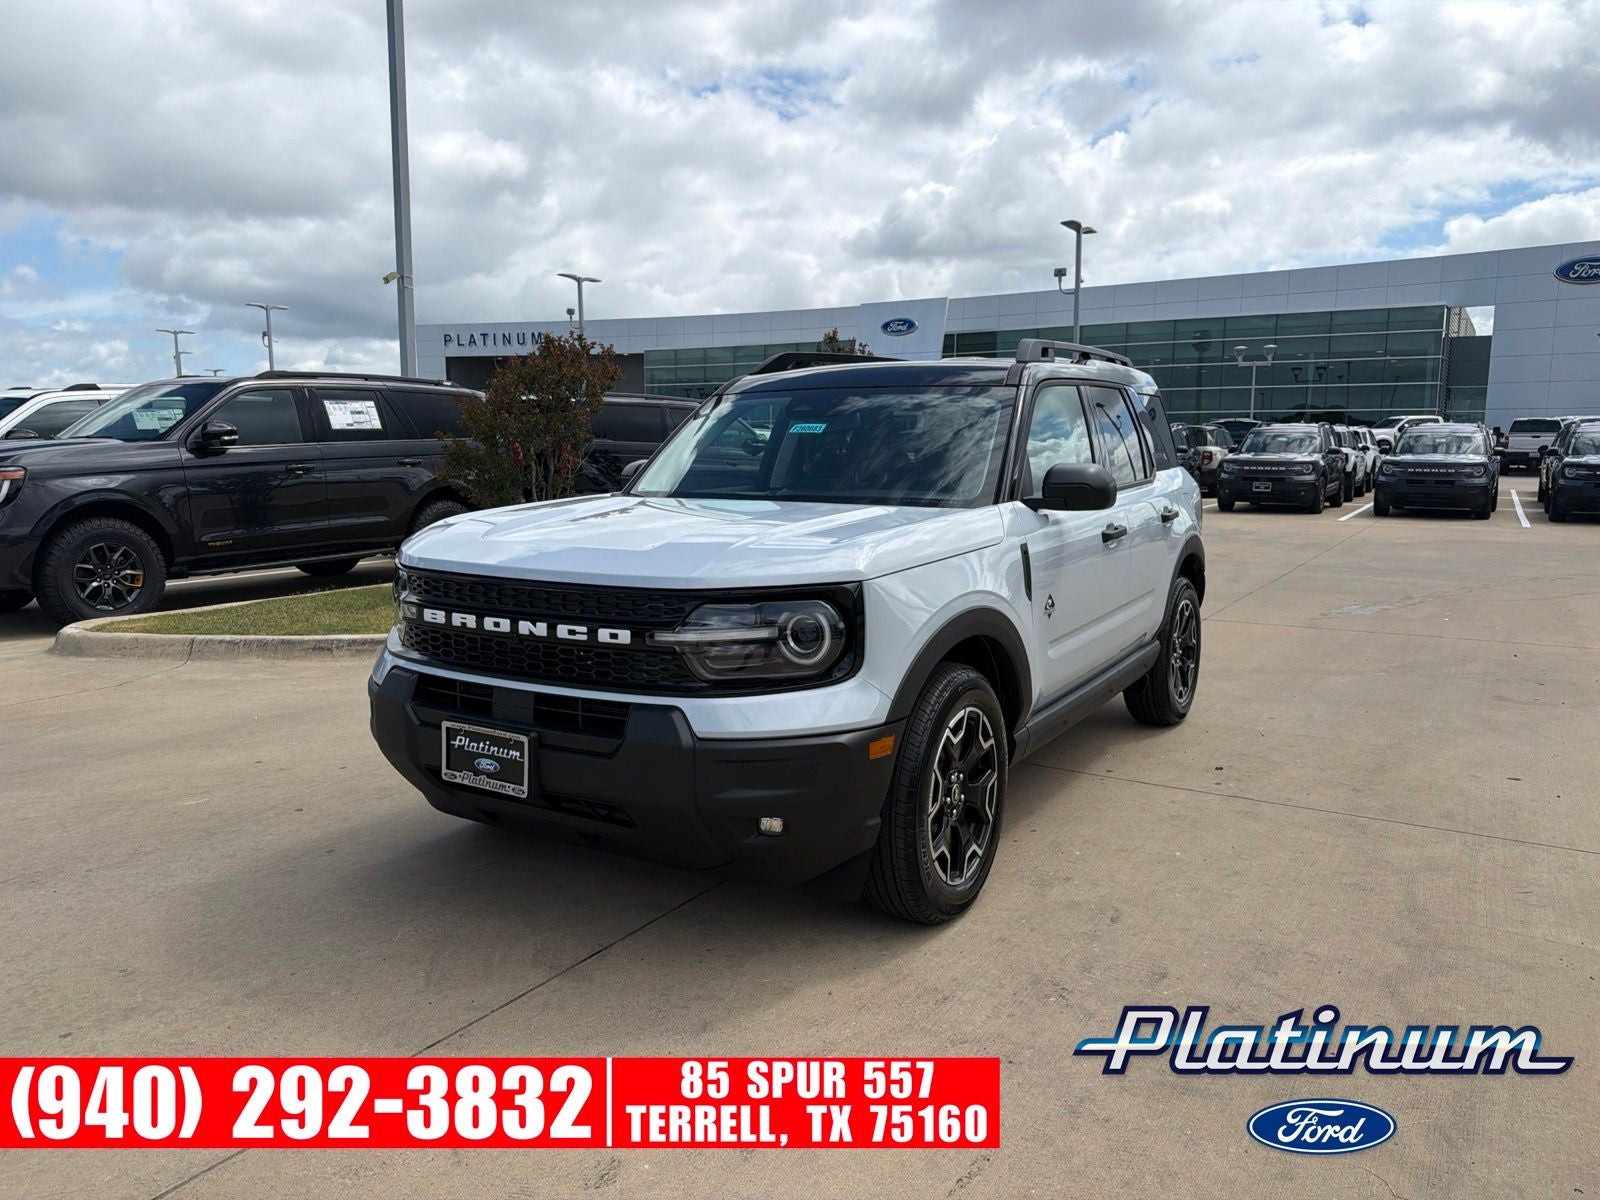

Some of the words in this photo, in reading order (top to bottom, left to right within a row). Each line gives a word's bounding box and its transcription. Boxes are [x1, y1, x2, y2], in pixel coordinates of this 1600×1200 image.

[1569, 261, 1600, 278] For
[887, 321, 910, 332] Ford
[443, 332, 542, 347] PLATINUM
[423, 608, 632, 645] BRONCO
[450, 736, 524, 762] Platinum
[478, 759, 496, 771] Ford
[461, 771, 510, 793] Platinum
